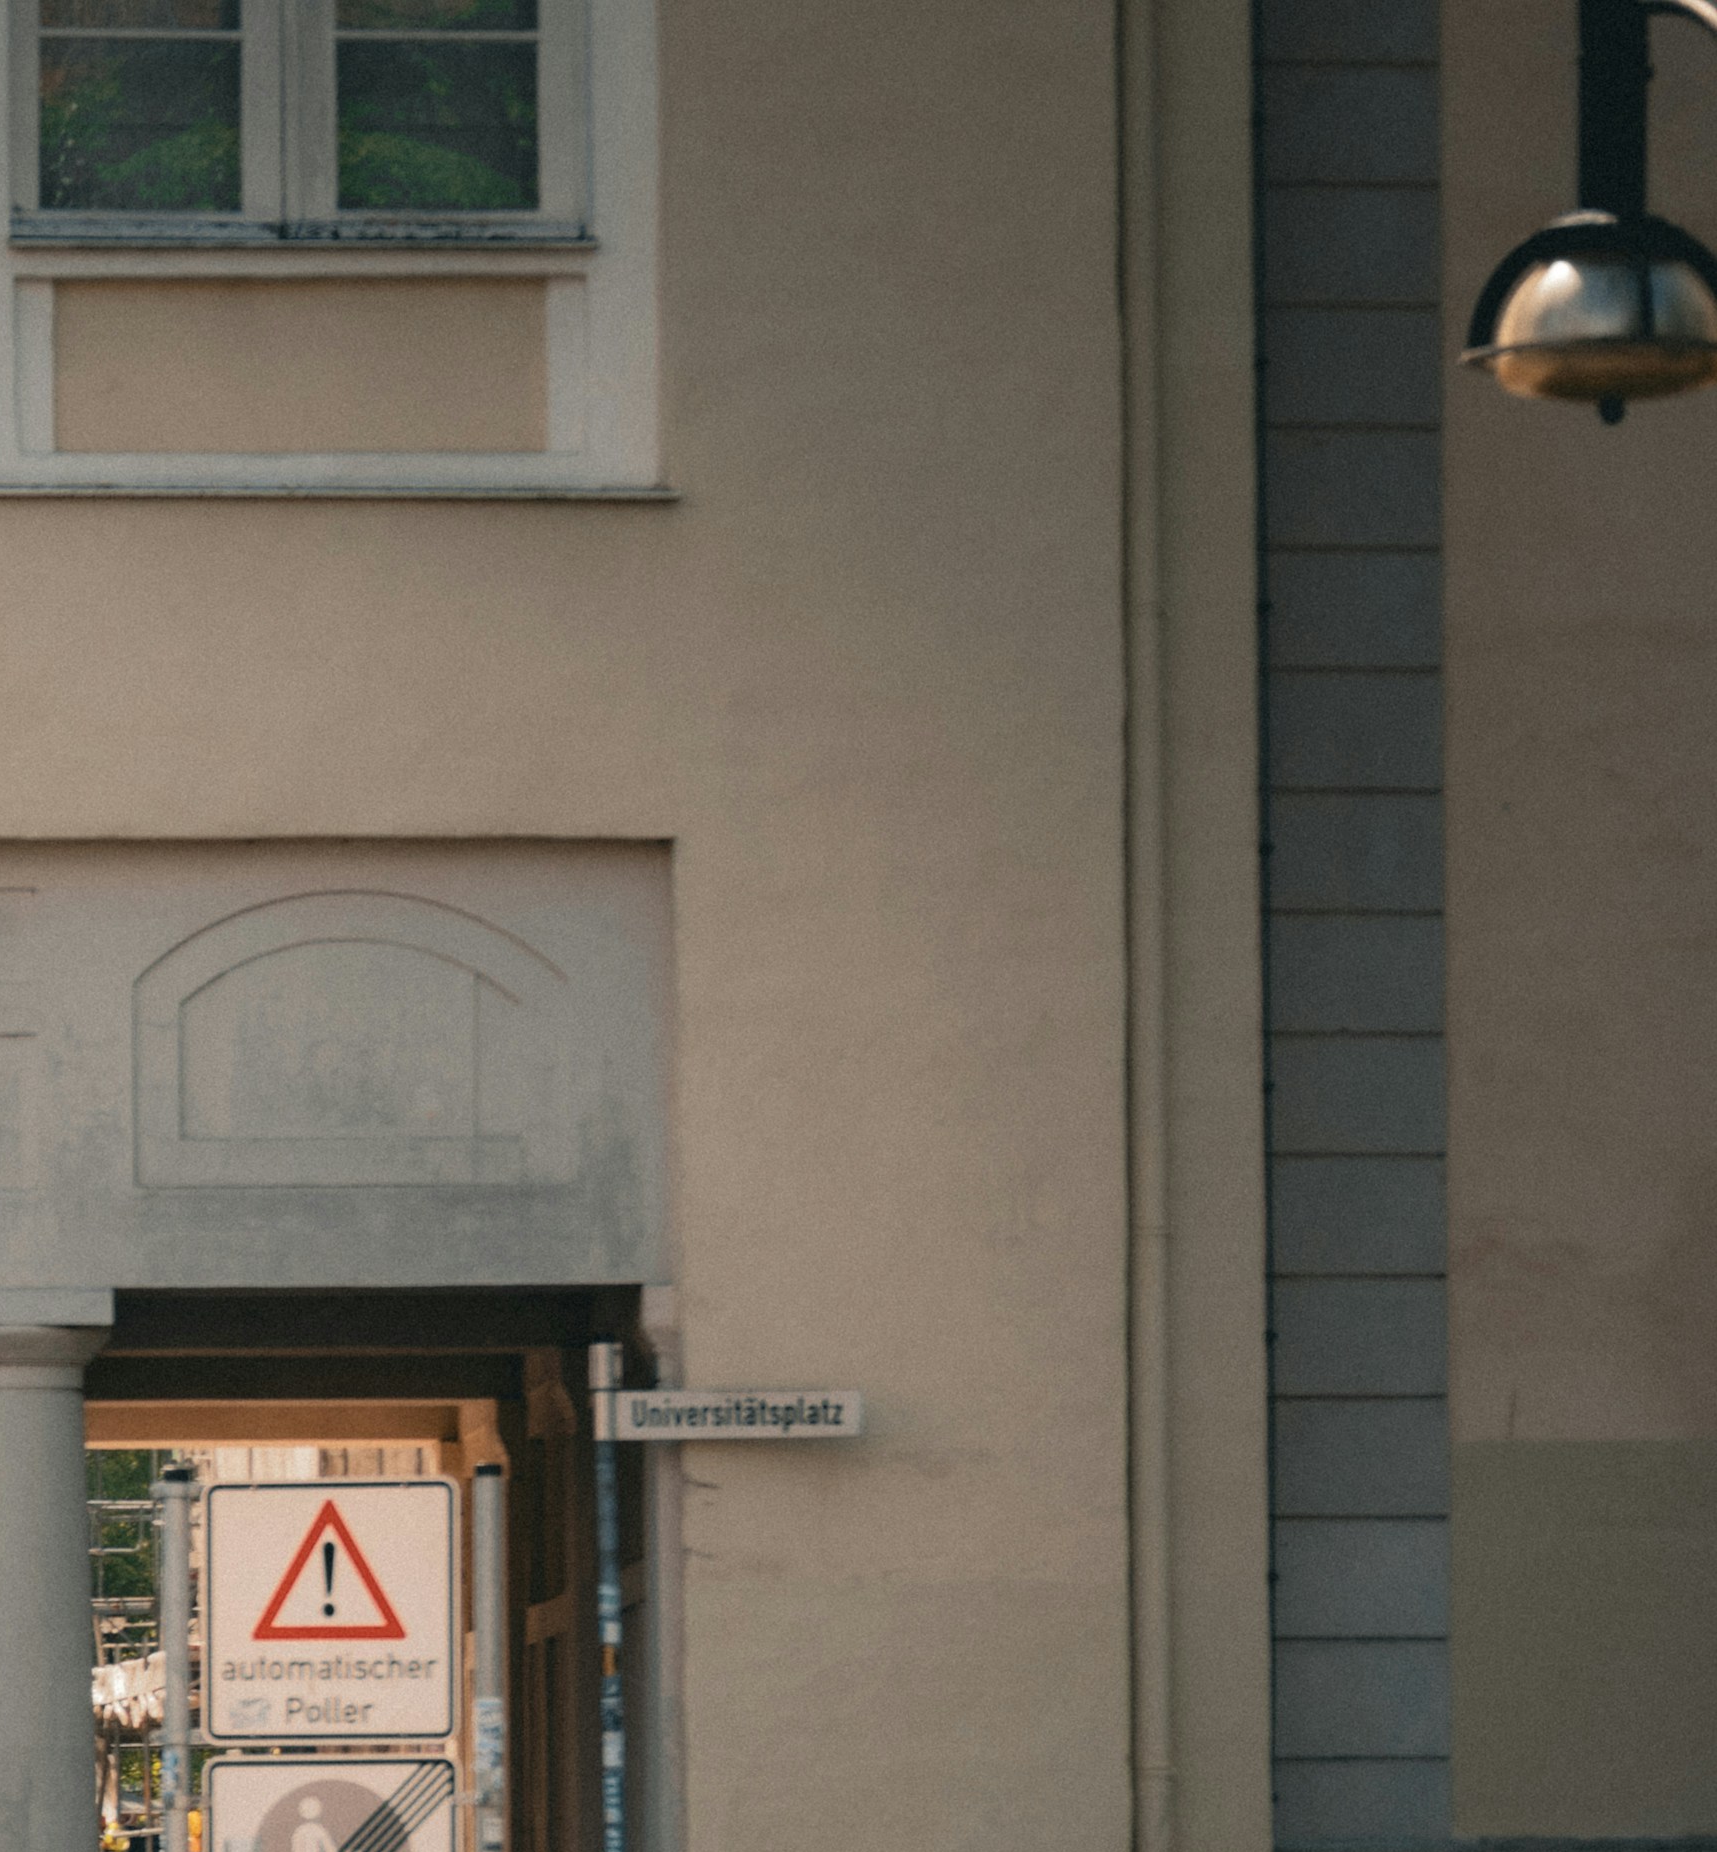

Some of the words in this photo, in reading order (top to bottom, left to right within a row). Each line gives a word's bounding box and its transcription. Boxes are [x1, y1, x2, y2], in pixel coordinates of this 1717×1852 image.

[631, 1397, 845, 1432] Universitätsplatz
[221, 1654, 438, 1683] automatischer
[285, 1697, 374, 1725] Poller
